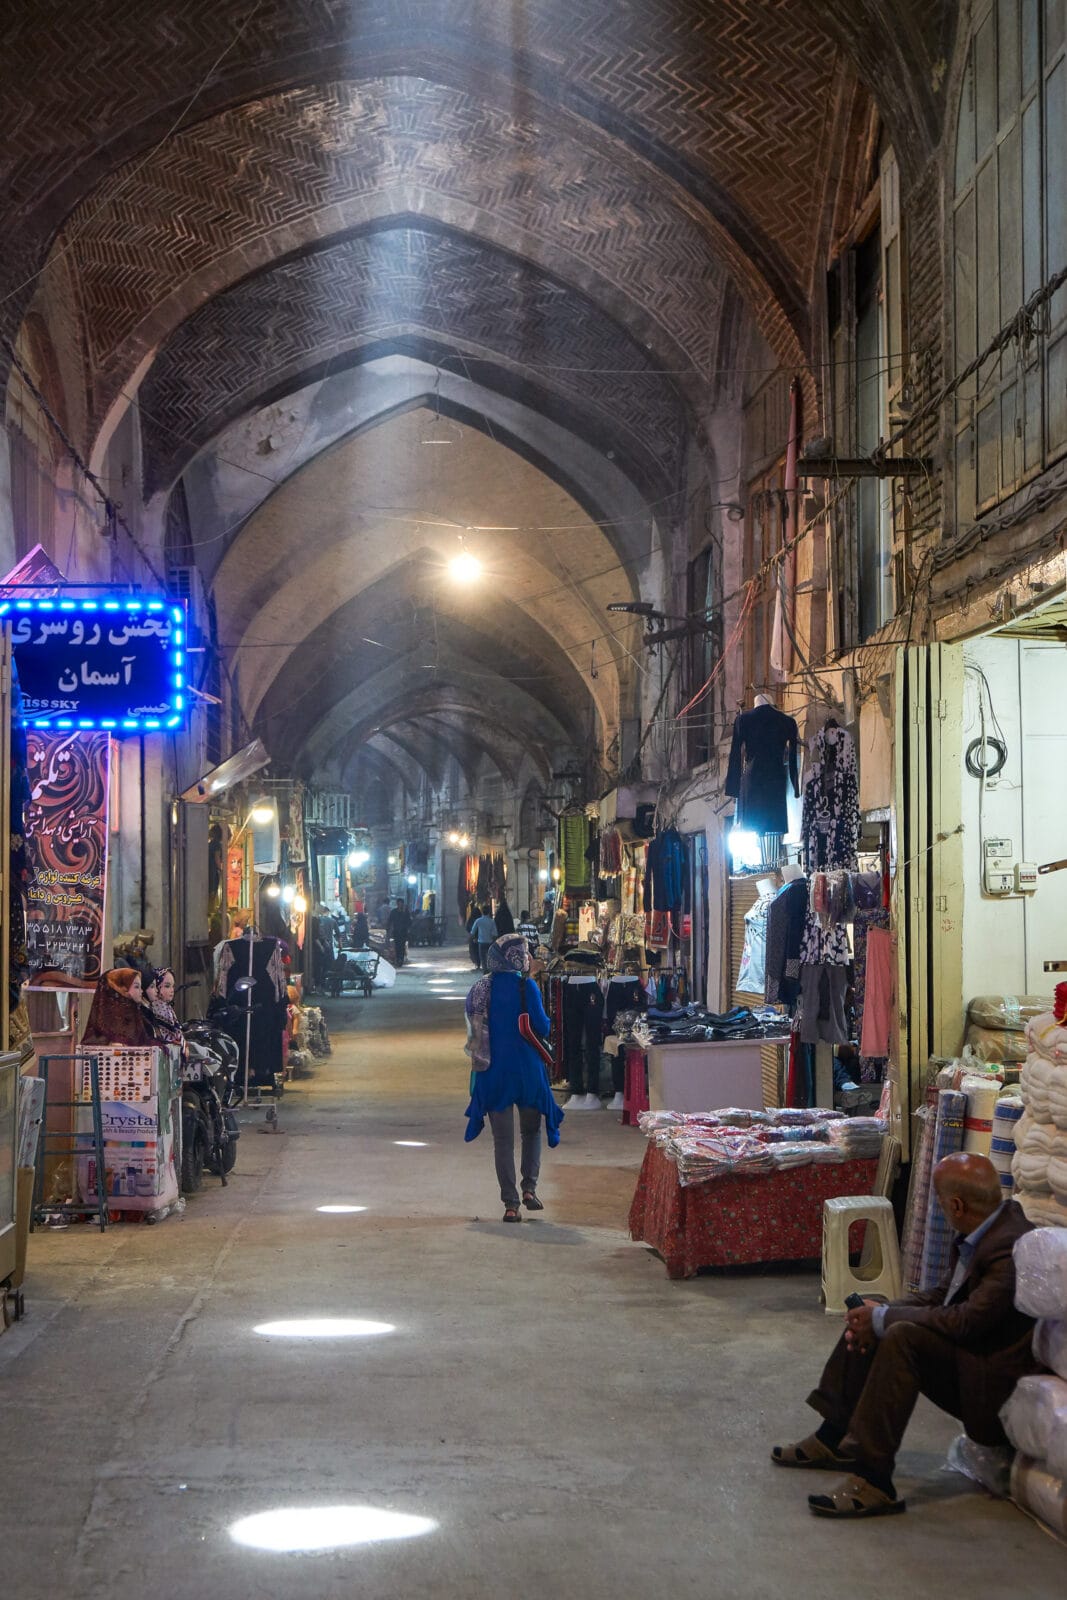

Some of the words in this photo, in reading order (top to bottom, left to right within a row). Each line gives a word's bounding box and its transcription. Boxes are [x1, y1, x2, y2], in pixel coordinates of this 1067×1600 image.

[11, 617, 101, 645] روسری
[108, 612, 172, 650] پخش
[58, 656, 136, 693] آسمان
[24, 698, 49, 708] ISS
[50, 700, 80, 709] SKY
[26, 806, 56, 848] بهداشتی
[56, 825, 62, 836] و
[61, 809, 98, 843] آرایشی
[28, 887, 46, 900] داما
[101, 1113, 158, 1128] Crystal
